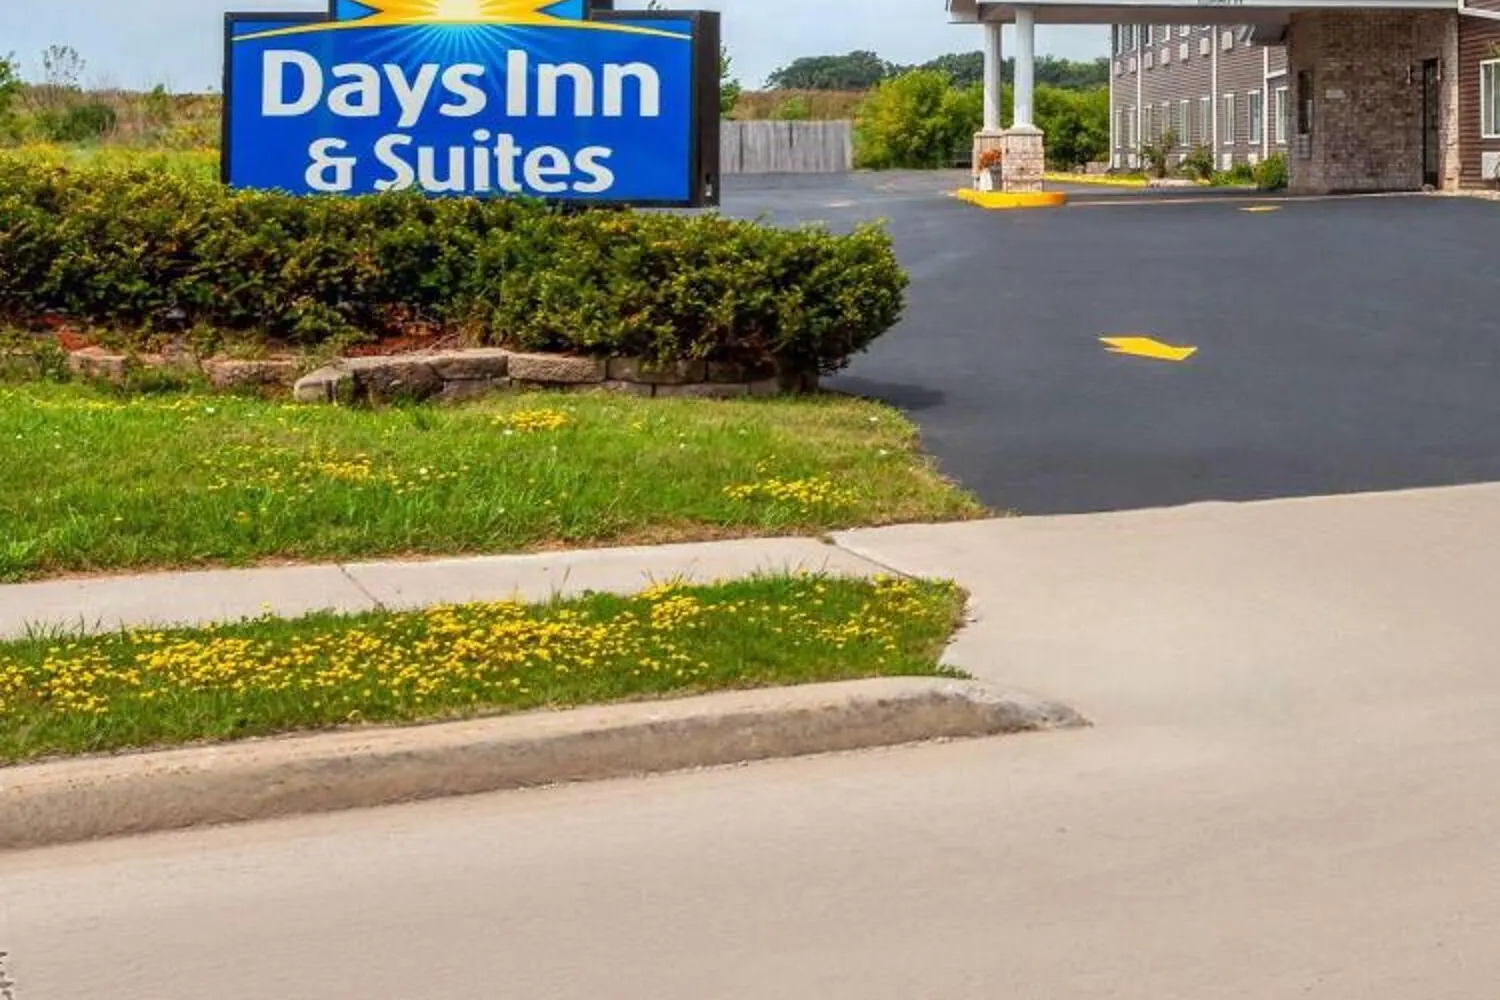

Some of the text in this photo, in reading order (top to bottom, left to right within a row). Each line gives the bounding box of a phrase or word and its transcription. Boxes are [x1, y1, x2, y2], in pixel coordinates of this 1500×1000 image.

[261, 49, 660, 127] Days Inn
[304, 129, 614, 193] & Suites
